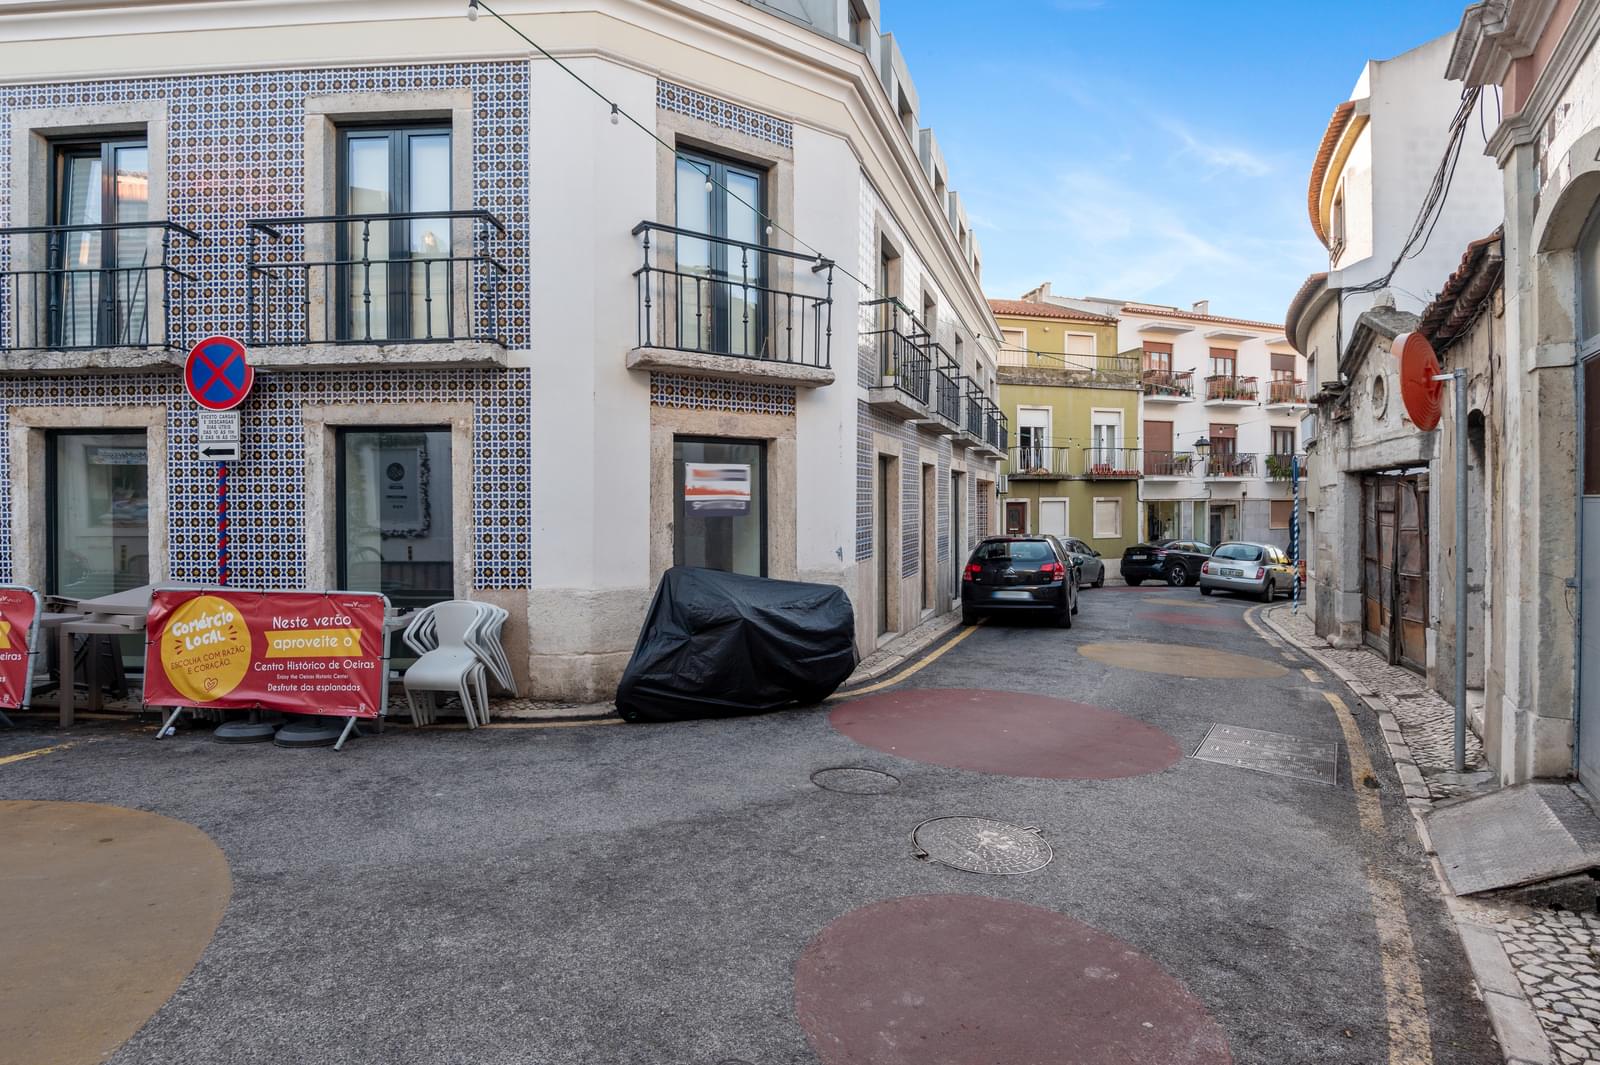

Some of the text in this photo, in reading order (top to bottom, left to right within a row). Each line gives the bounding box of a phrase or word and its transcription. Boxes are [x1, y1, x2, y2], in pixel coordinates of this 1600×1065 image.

[172, 606, 234, 637] Comércio
[272, 614, 352, 629] Neste verão
[185, 630, 226, 650] LOCAL
[273, 635, 353, 651] aproveite o
[171, 645, 245, 670] ESCOLHA COM RAZÃO
[254, 659, 375, 671] Centro Histórico de Oeiras
[187, 667, 192, 675] E
[267, 682, 361, 692] Desfrute das esplanadas
